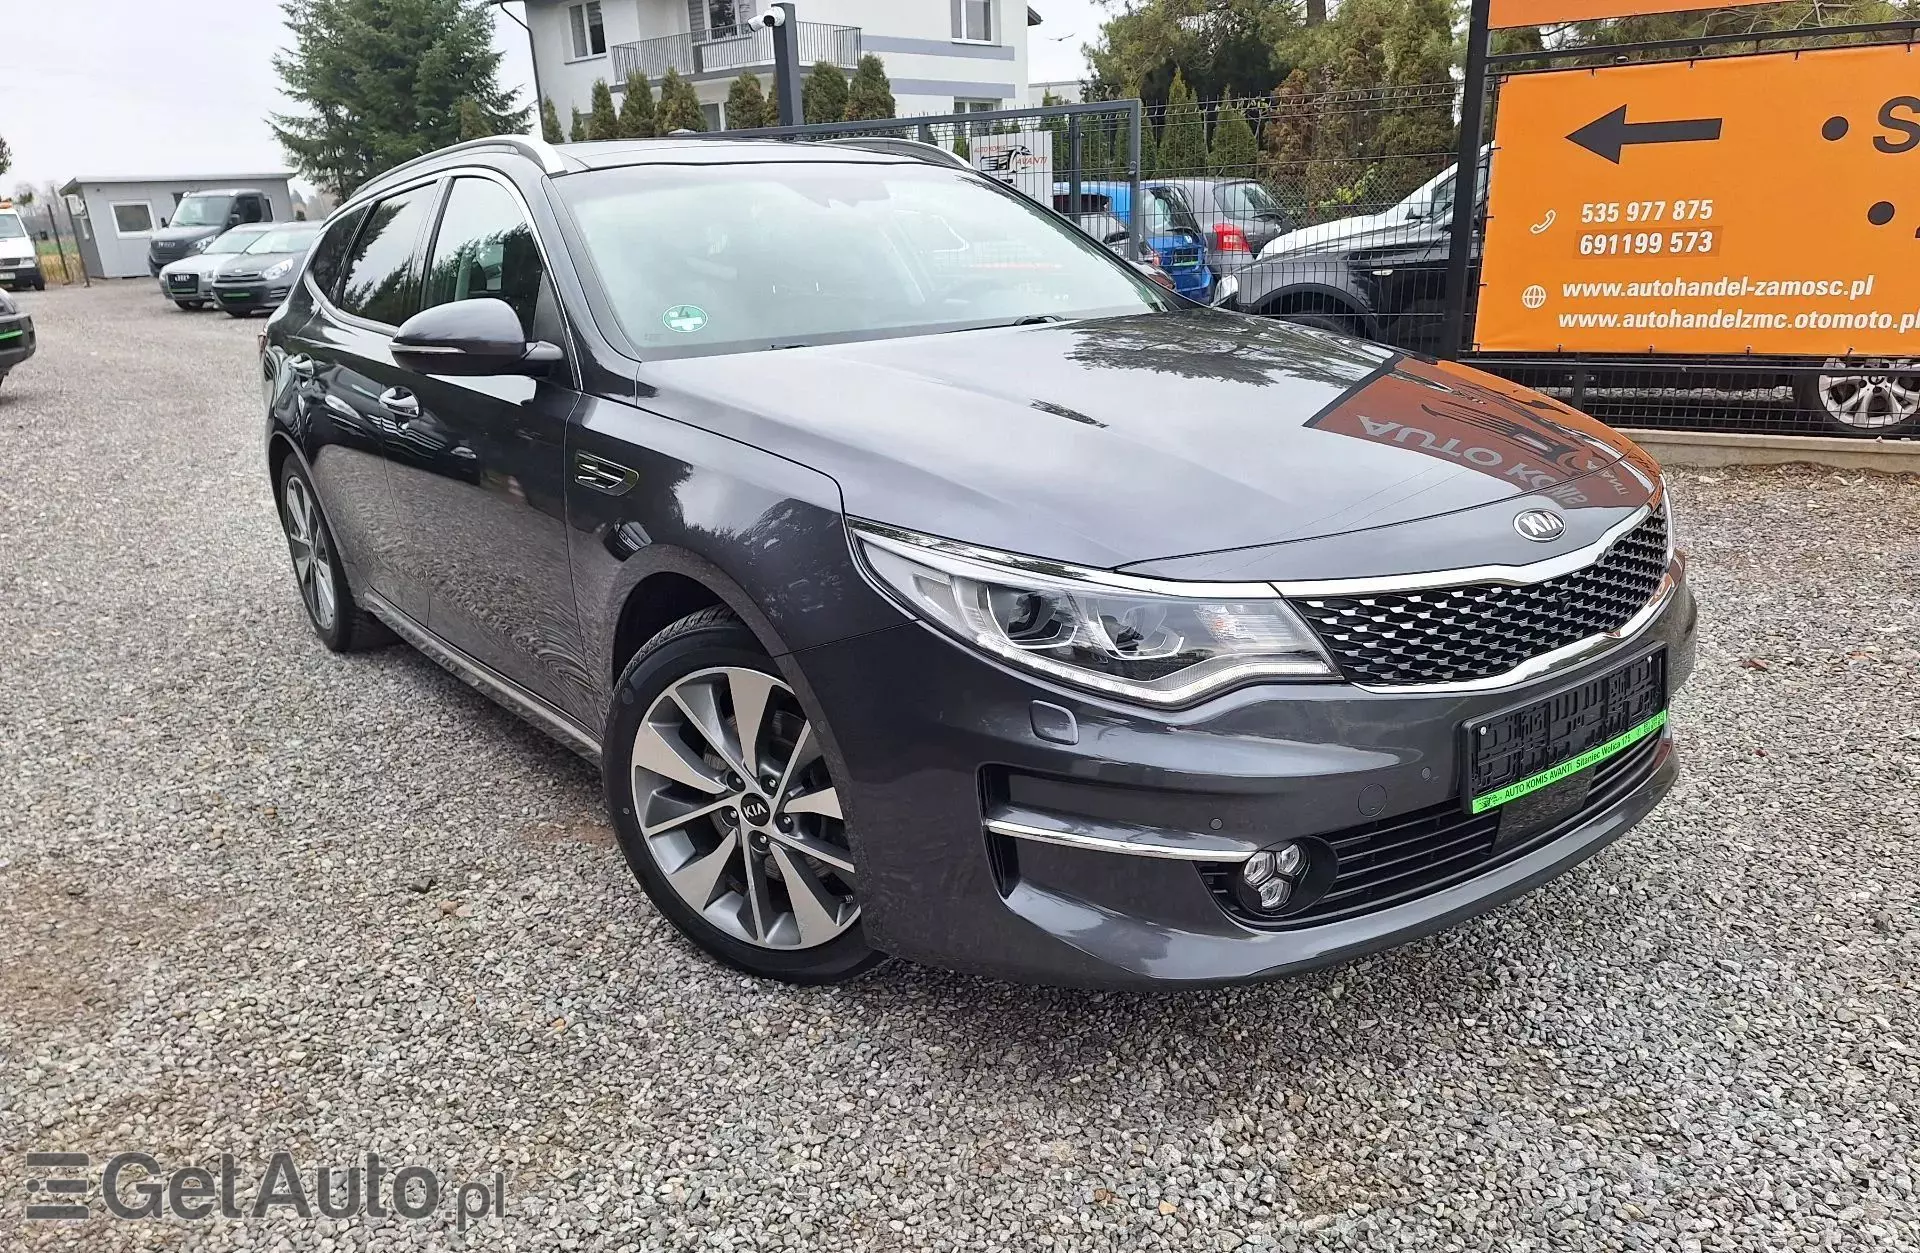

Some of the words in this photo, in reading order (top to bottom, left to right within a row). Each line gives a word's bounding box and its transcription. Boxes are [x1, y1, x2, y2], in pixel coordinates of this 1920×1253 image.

[1017, 156, 1047, 165] AVANTI
[1581, 202, 1619, 223] 535
[1626, 201, 1666, 222] 977
[1672, 199, 1713, 221] 875
[1669, 230, 1713, 253] 573
[1562, 275, 1874, 300] www.autohandel-zamosc.pl
[1558, 308, 1920, 333] www.autohandelzmc.otomoto.pl
[1521, 510, 1564, 537] KIA
[1505, 783, 1525, 799] AUTO
[1526, 774, 1548, 789] KOMIS
[1549, 762, 1573, 780] AVANTI
[743, 802, 767, 818] KIA
